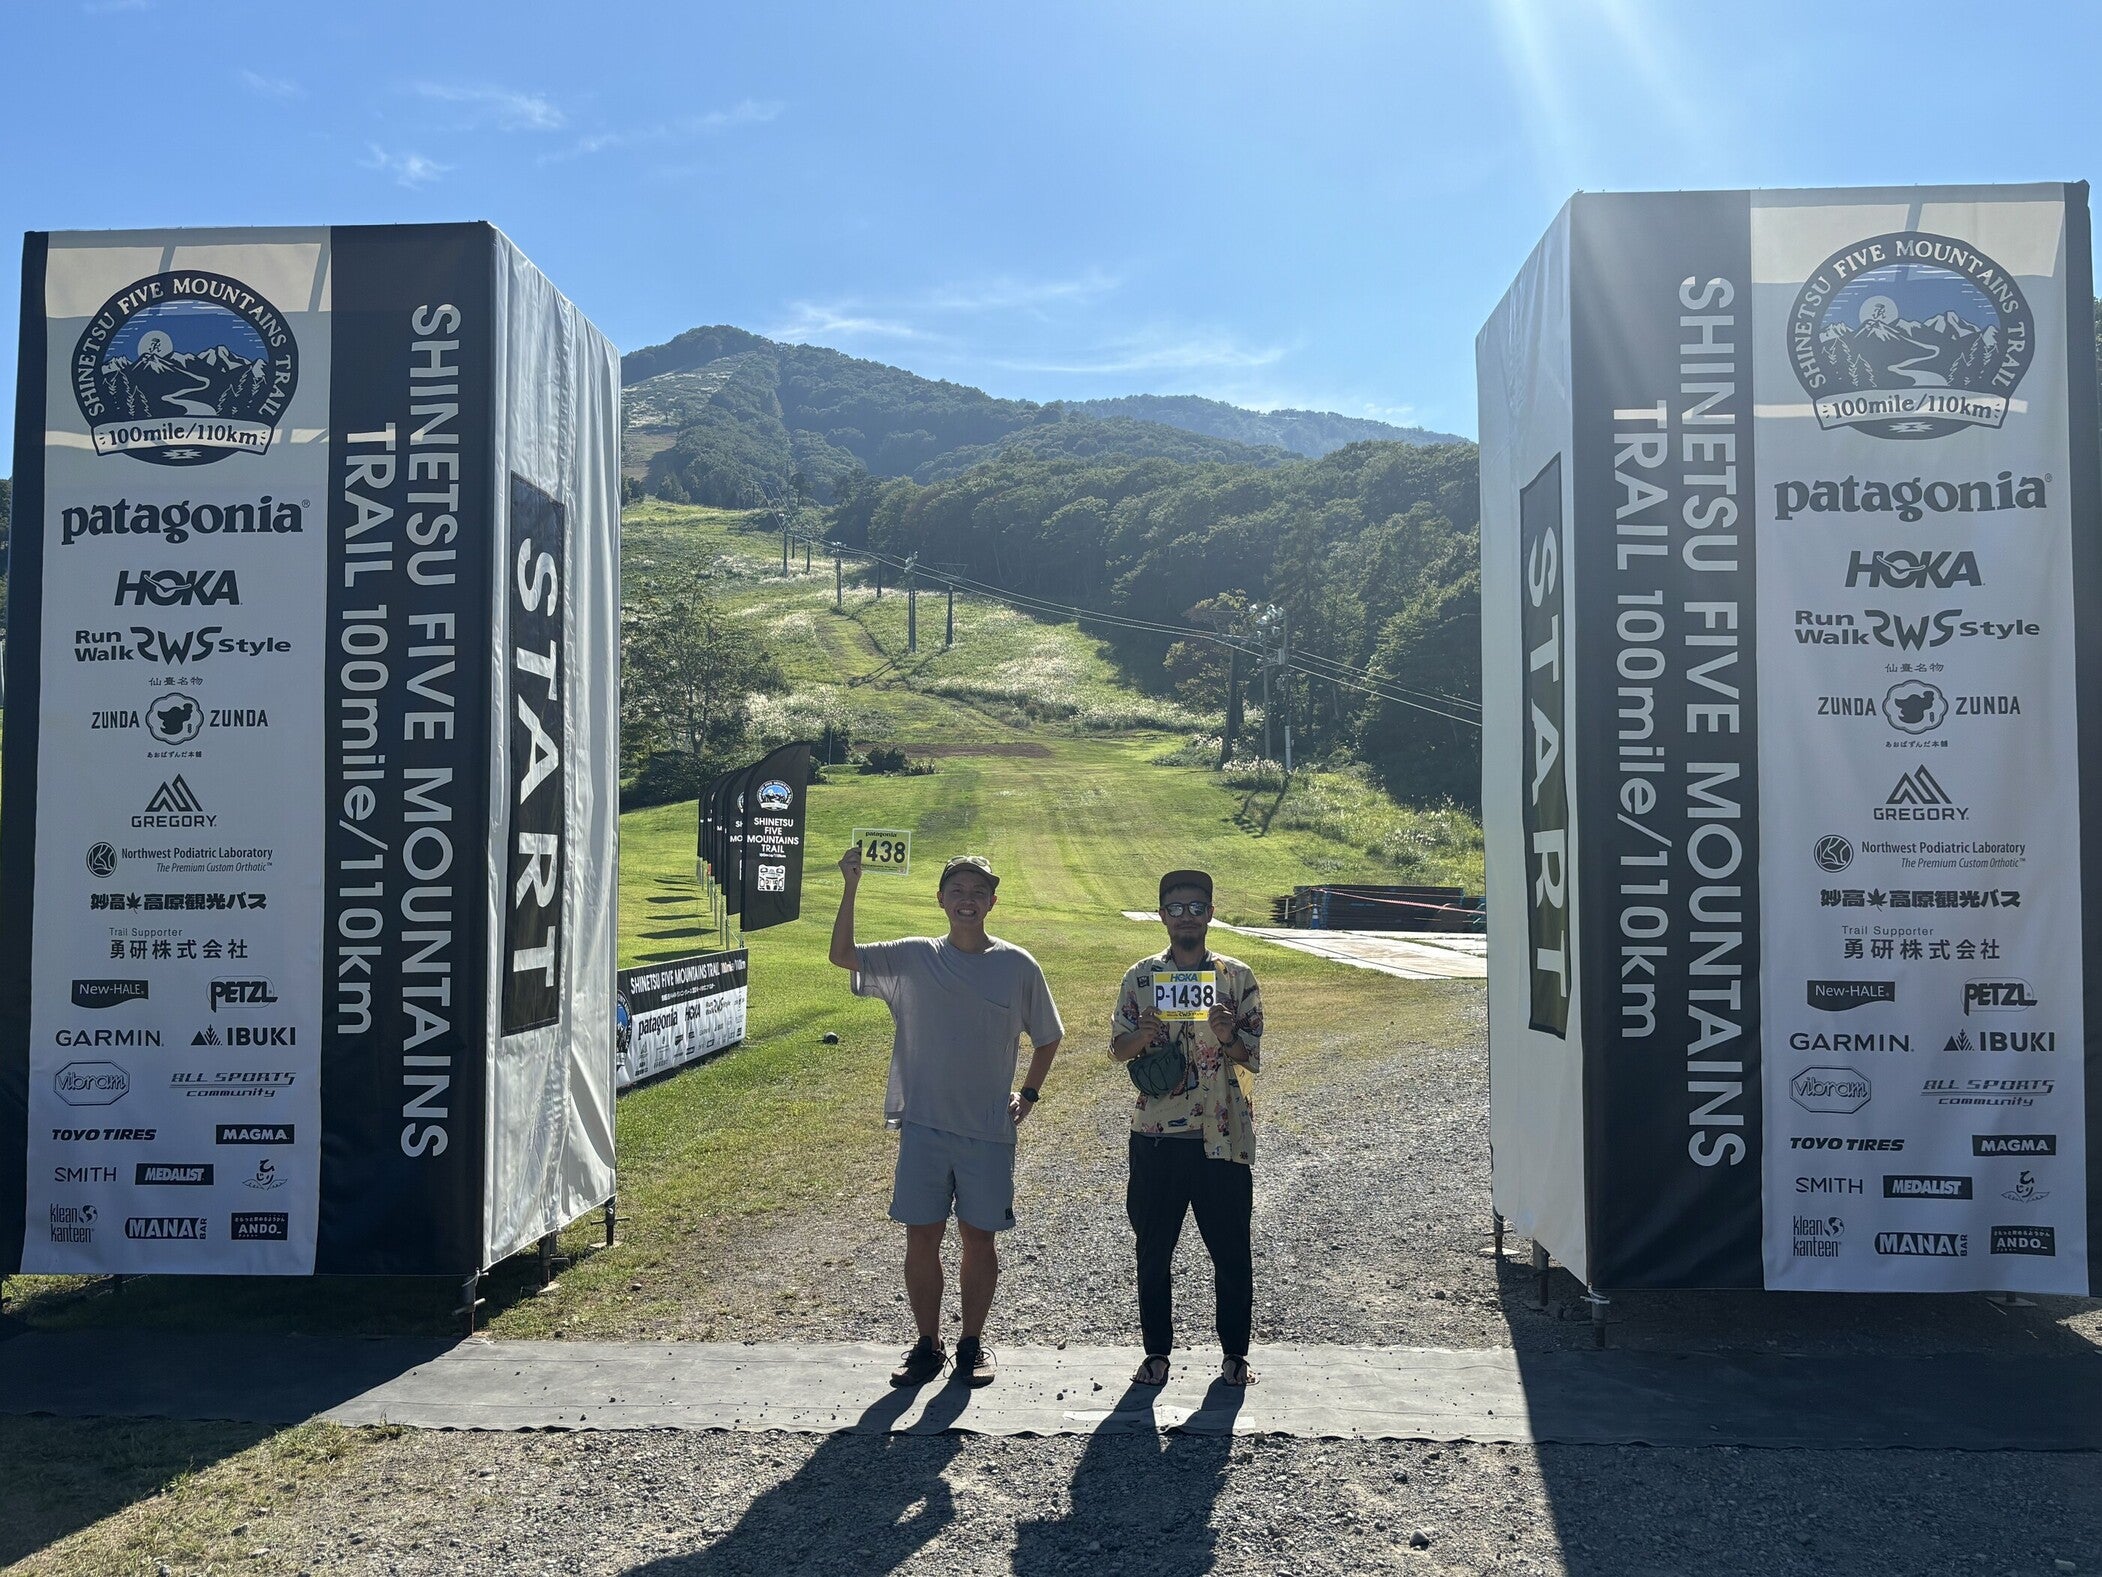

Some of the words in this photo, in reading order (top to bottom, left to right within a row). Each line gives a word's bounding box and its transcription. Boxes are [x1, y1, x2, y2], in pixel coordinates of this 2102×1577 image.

[1794, 276, 1832, 389] SHINETSU
[1833, 244, 1886, 280] FIVE
[1895, 240, 2019, 314] MOUNTAINS
[1991, 322, 2026, 388] TRAIL
[77, 312, 115, 417] SHINETSU
[117, 281, 164, 316] FIVE
[173, 277, 287, 348] MOUNTAINS
[258, 353, 292, 418] TRAIL
[1833, 393, 1992, 420] 100mile/110km
[1679, 276, 1738, 571] SHINETSU
[109, 422, 259, 447] 100mile/110km
[406, 303, 461, 586] SHINETSU
[1613, 400, 1668, 570] TRAIL
[344, 422, 396, 588] TRAIL
[1844, 550, 1985, 589] HOKA
[114, 570, 241, 606] HOKA
[1794, 610, 1855, 626] Run
[75, 630, 122, 645] Run
[1794, 629, 1870, 645] Walk
[1864, 609, 1963, 651] RWS
[1959, 619, 2040, 639] Style
[74, 646, 134, 662] Walk
[130, 626, 222, 666] RWS
[218, 637, 291, 656] Style
[404, 612, 455, 740] FIVE
[1683, 600, 1740, 734] FIVE
[1817, 697, 1877, 716] ZUNDA
[1955, 696, 2021, 715] ZUNDA
[91, 710, 140, 730] ZUNDA
[209, 709, 269, 728] ZUNDA
[513, 537, 558, 987] START
[1528, 526, 1567, 998] START
[131, 815, 217, 828] GREGORY
[337, 604, 388, 1034] 100mile/110km
[754, 817, 794, 827] SHINETSU
[1616, 589, 1672, 1038] 100mile/110km
[1873, 807, 1969, 821] GREGORY
[746, 835, 799, 845] MOUNTAINS
[764, 827, 782, 835] FIVE
[121, 847, 172, 860] Northwest
[173, 847, 217, 860] Podiatric
[218, 847, 273, 861] Laboratory
[761, 844, 785, 853] TRAIL
[1861, 841, 1917, 854] Northwest
[1919, 841, 1970, 854] Podiatric
[1972, 841, 2025, 856] Laboratory
[156, 862, 170, 873] The
[171, 863, 205, 873] Premium
[206, 863, 235, 873] Custom
[1901, 857, 1916, 868] The
[1917, 857, 1957, 868] Premium
[1958, 857, 1988, 868] Custom
[109, 928, 128, 937] Trail
[131, 928, 183, 938] Supporter
[1842, 925, 1869, 936] Trail
[1873, 925, 1934, 937] Supporter
[110, 939, 249, 960] 勇研株式会社
[1843, 938, 2000, 960] 勇研株式会社
[400, 768, 453, 1157] MOUNTAINS
[1686, 761, 1746, 1167] MOUNTAINS
[630, 973, 660, 995] SHINETSU
[661, 970, 674, 988] FIVE
[1170, 973, 1198, 982] HOKA
[210, 981, 279, 1012] PETZL
[1155, 984, 1214, 1008] P-1438
[1963, 983, 2038, 1016] PETZL
[638, 1008, 678, 1040] patagonia
[685, 1001, 700, 1021] HOKA
[55, 1029, 161, 1047] GARMIN
[227, 1027, 296, 1046] IBUKI
[1789, 1032, 1911, 1052] GARMIN
[1980, 1032, 2055, 1051] IBUKI
[57, 1071, 126, 1091] vibram
[172, 1072, 208, 1083] ALL
[214, 1072, 296, 1086] SPORTS
[1794, 1077, 1868, 1098] vibram
[1923, 1080, 1959, 1090] ALL
[1967, 1079, 2055, 1094] SPORTS
[186, 1087, 275, 1097] community
[1938, 1096, 2033, 1107] community
[52, 1129, 100, 1140] TOYO
[103, 1128, 157, 1140] TIRES
[222, 1129, 288, 1140] MAGMA
[1790, 1137, 1842, 1150] TOYO
[1846, 1138, 1904, 1151] TIRES
[1981, 1139, 2049, 1151] MAGMA
[54, 1167, 117, 1182] SMITH
[144, 1167, 204, 1181] MEDALIST
[1796, 1177, 1863, 1194] SMITH
[1892, 1179, 1962, 1195] MEDALIST
[50, 1203, 78, 1224] klean
[51, 1225, 93, 1243] kanteen
[129, 1218, 195, 1238] MANA
[199, 1217, 208, 1239] BAR
[1793, 1215, 1822, 1236] klean
[1793, 1237, 1838, 1257] kanteen
[1879, 1233, 1954, 1254] MANA
[1960, 1234, 1968, 1256] BAR
